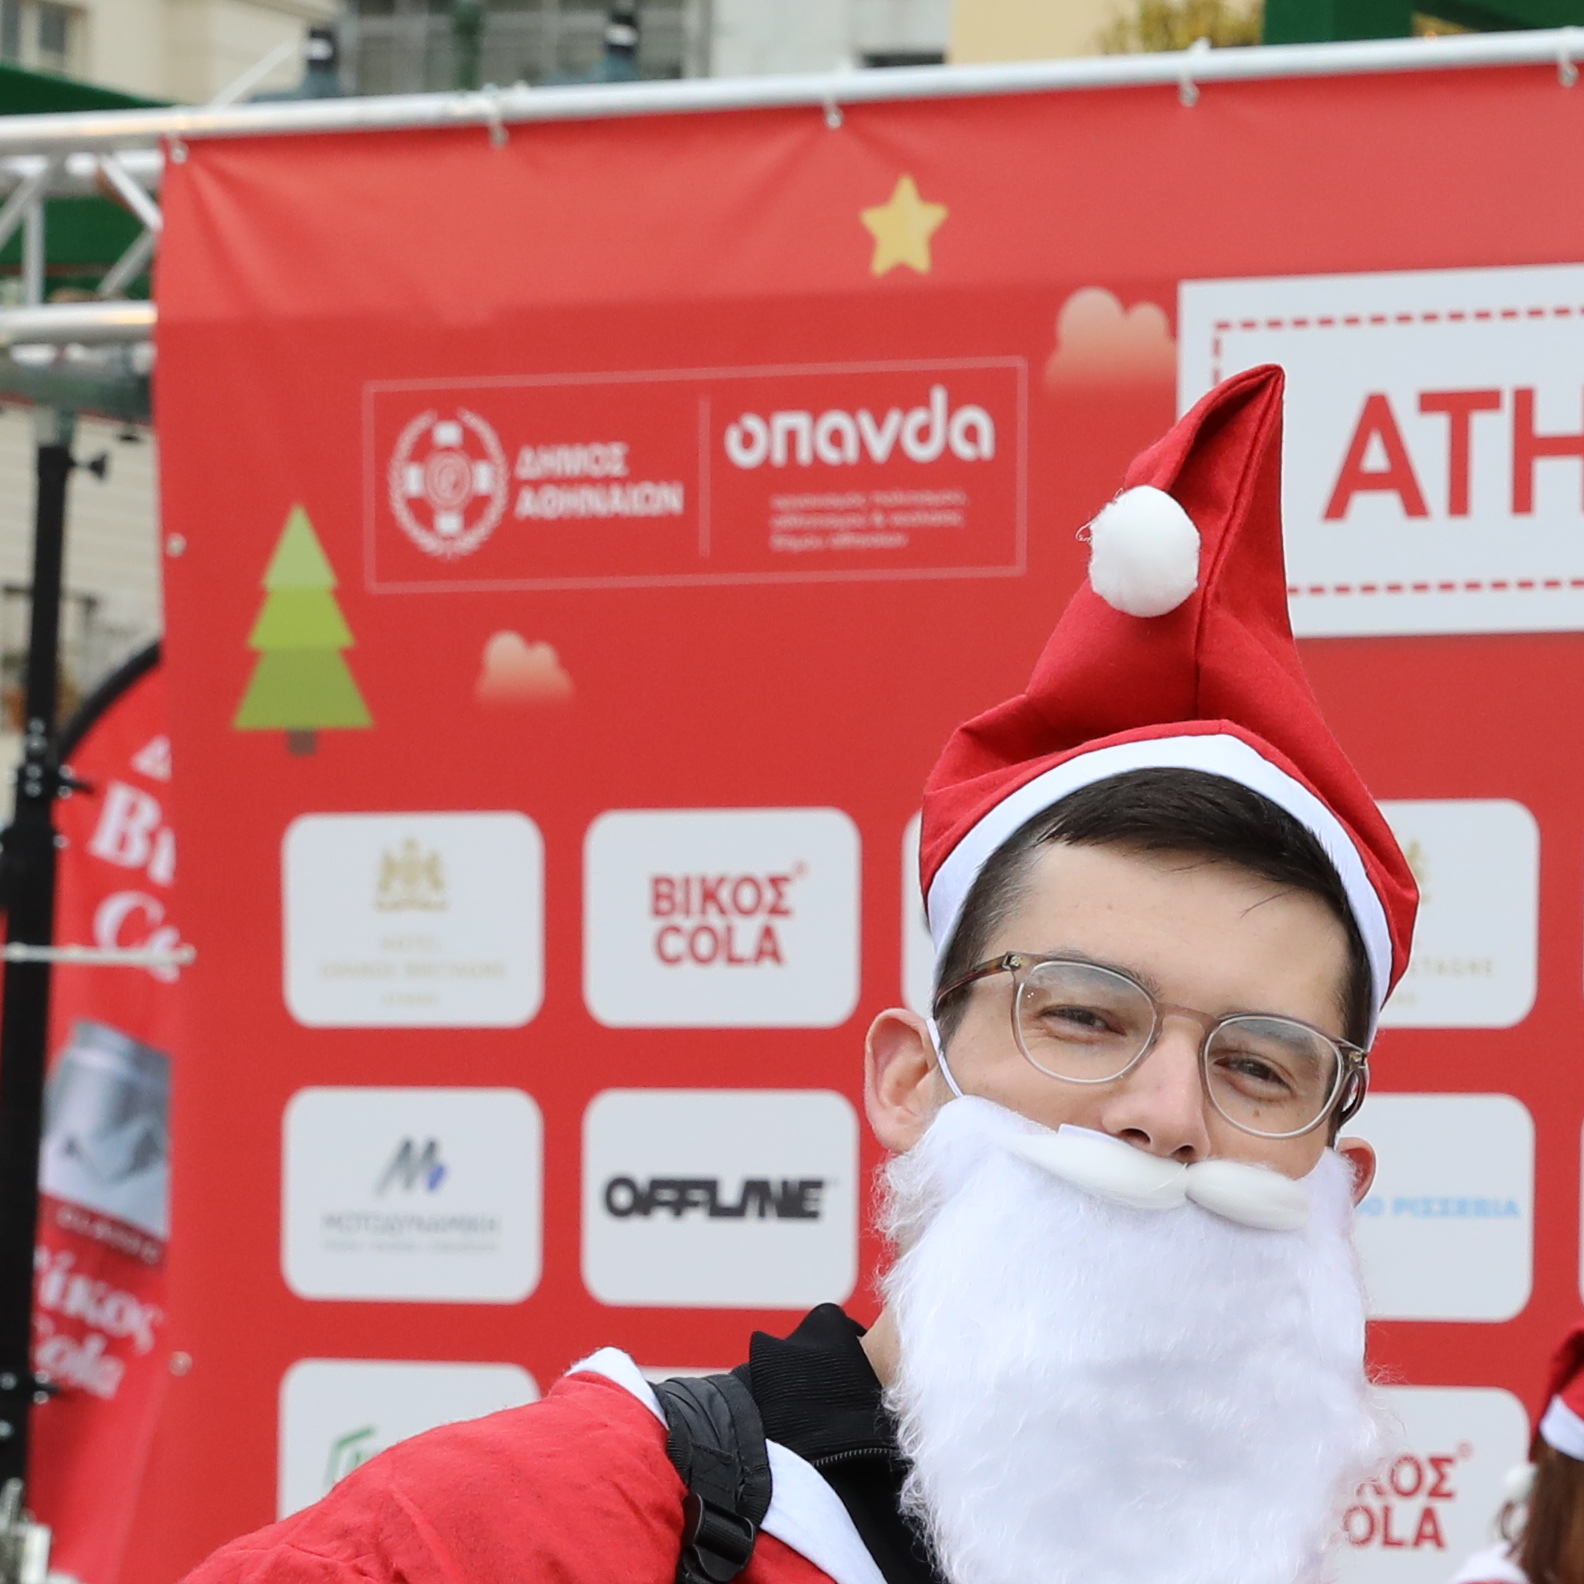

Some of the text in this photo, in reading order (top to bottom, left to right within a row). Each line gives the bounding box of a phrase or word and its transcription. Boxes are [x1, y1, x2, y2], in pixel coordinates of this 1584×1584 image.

[649, 873, 795, 920] ΒΙΚΟΣ
[655, 922, 784, 967] COLA
[1342, 1505, 1445, 1549] OLA
